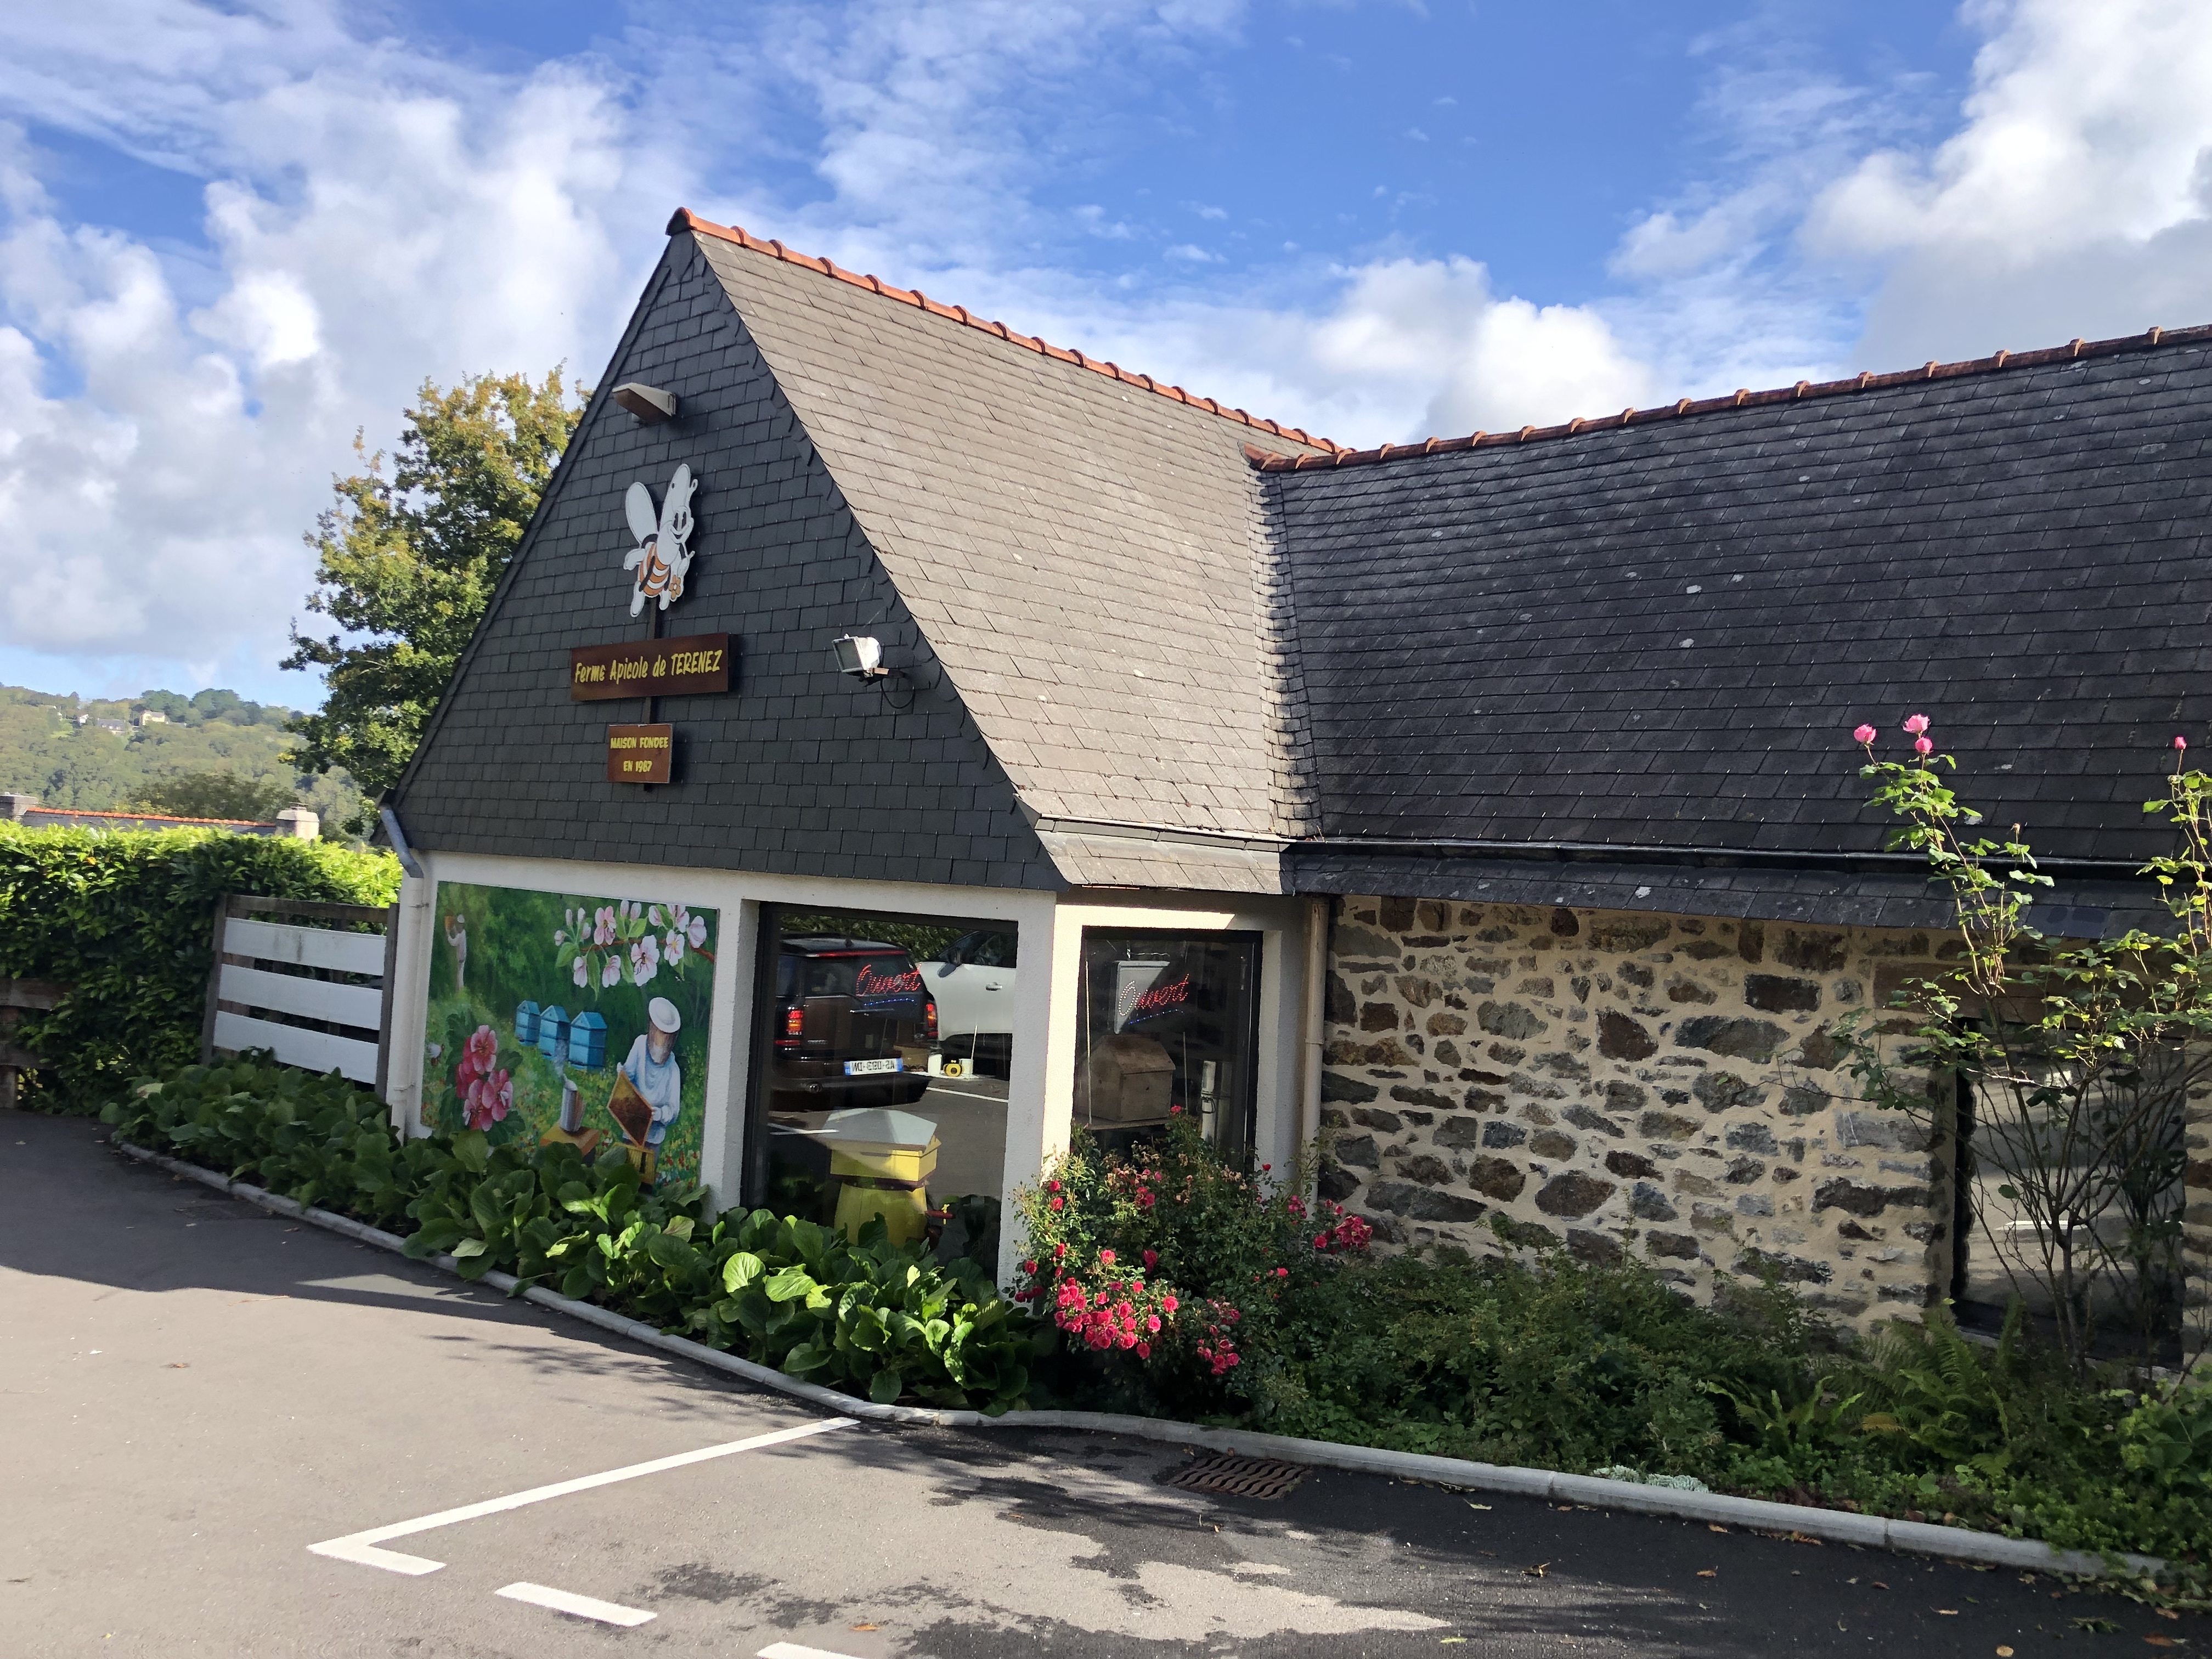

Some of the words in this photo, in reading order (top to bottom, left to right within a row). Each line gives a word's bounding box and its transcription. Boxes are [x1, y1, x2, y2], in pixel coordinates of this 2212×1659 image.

[575, 663, 606, 683] Ferme
[610, 656, 648, 685] Apicole
[652, 654, 667, 677] de
[671, 649, 723, 675] TERENEZ
[610, 737, 637, 749] MAISON
[640, 736, 669, 748] FONDEE
[623, 760, 633, 771] EN
[635, 760, 652, 772] 1987
[856, 963, 922, 996] Ouvert
[1118, 973, 1189, 1016] Ouvert
